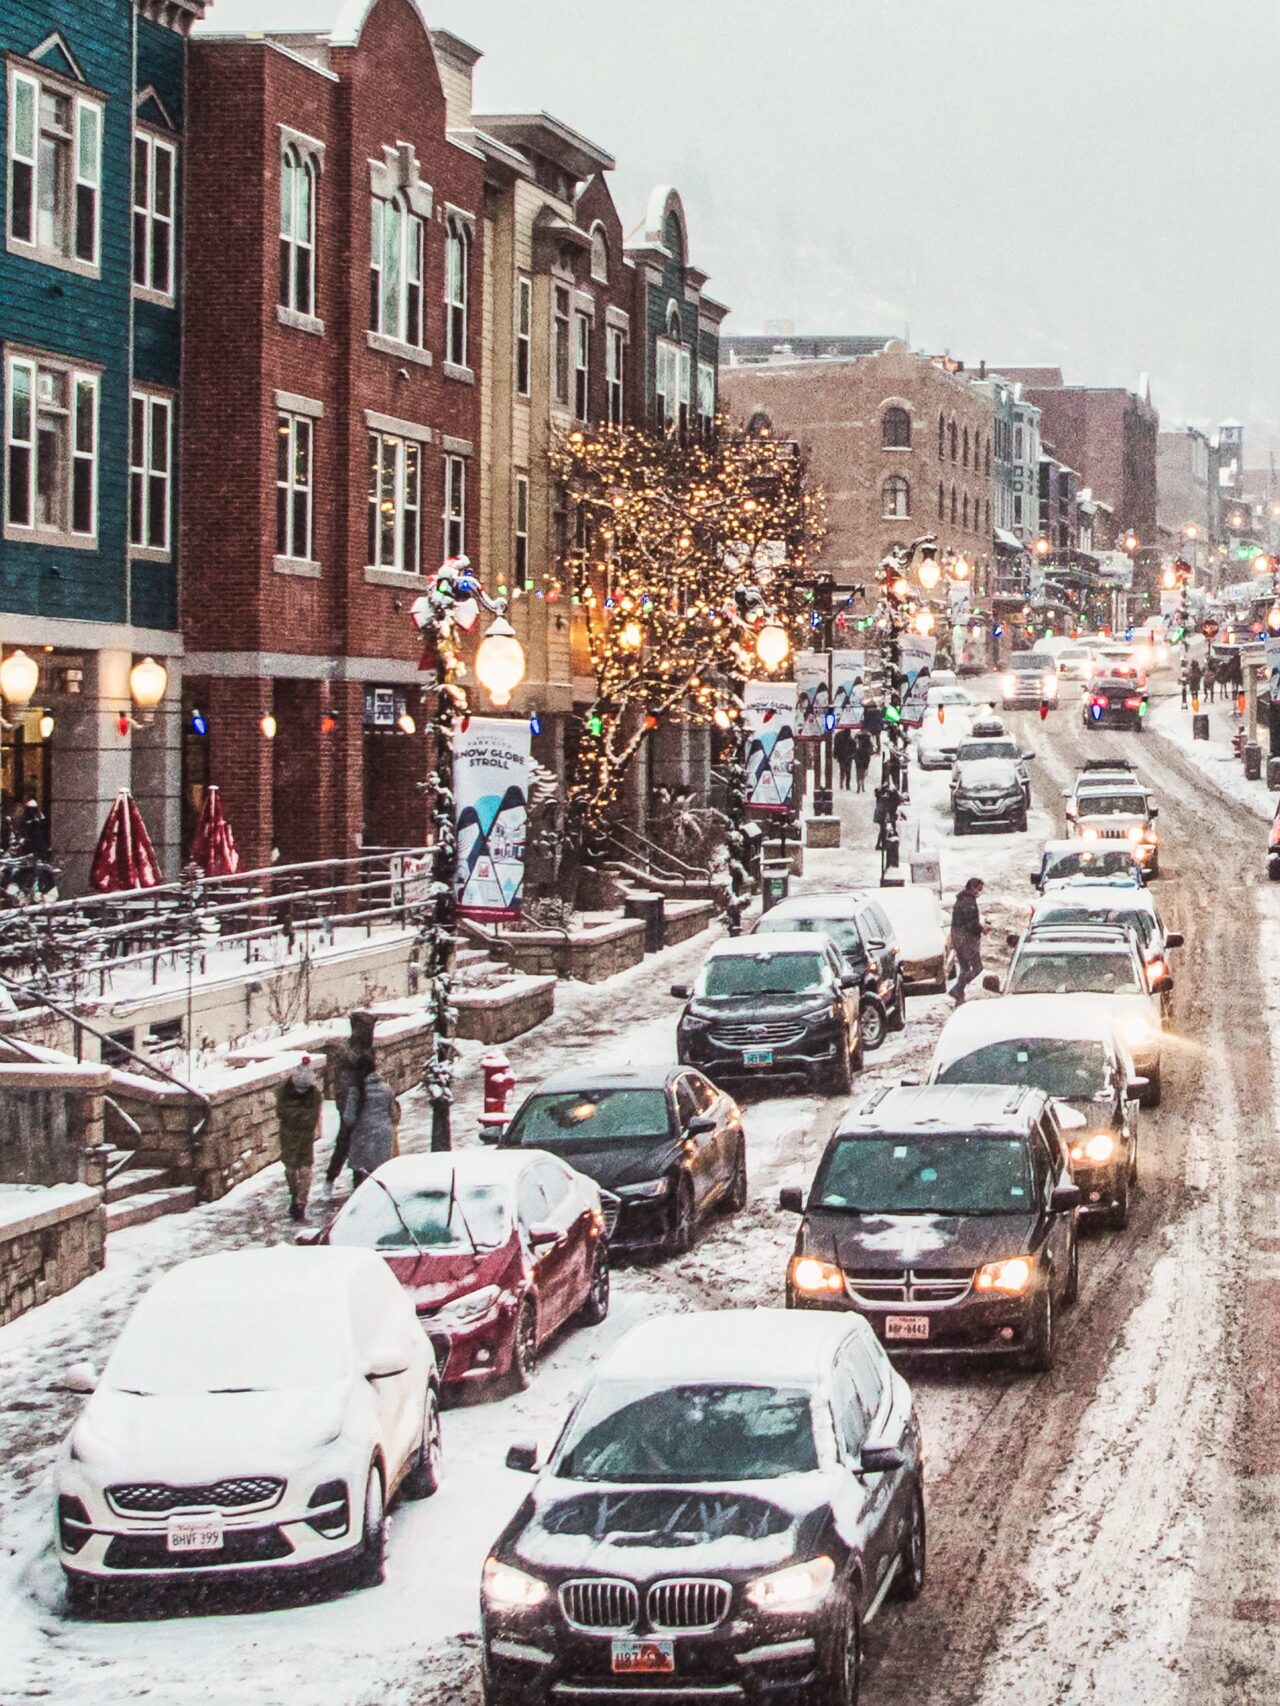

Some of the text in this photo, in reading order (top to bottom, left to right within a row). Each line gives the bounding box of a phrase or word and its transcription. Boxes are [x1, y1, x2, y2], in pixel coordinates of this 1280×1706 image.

[455, 748, 526, 765] SNOW GLOBE
[470, 758, 510, 770] STROLL
